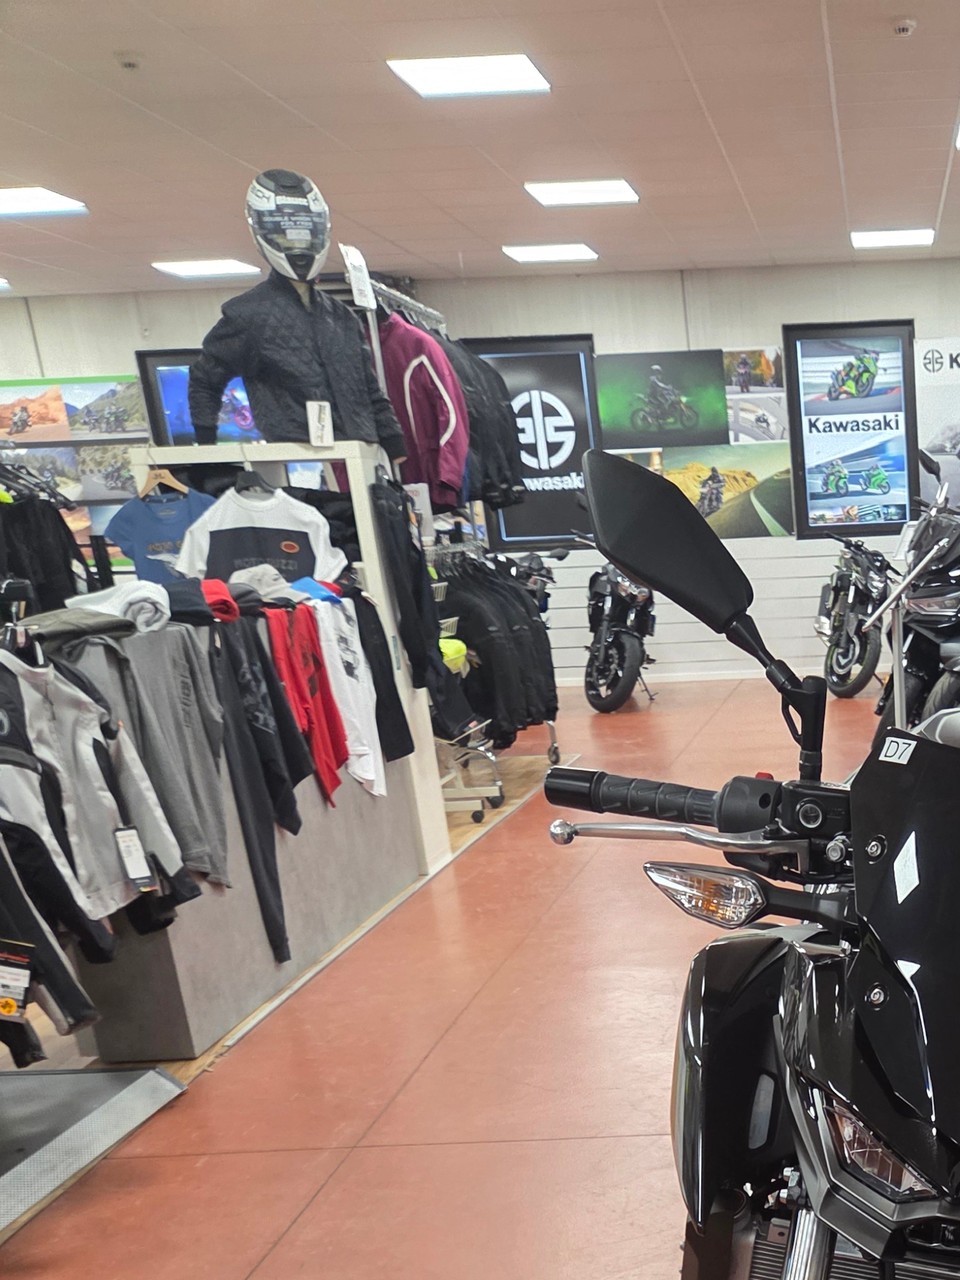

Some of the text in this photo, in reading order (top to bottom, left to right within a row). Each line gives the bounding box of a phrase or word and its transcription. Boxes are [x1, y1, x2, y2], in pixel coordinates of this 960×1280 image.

[808, 414, 900, 434] Kawasaki
[522, 471, 585, 491] wasaki
[884, 740, 912, 760] D7
